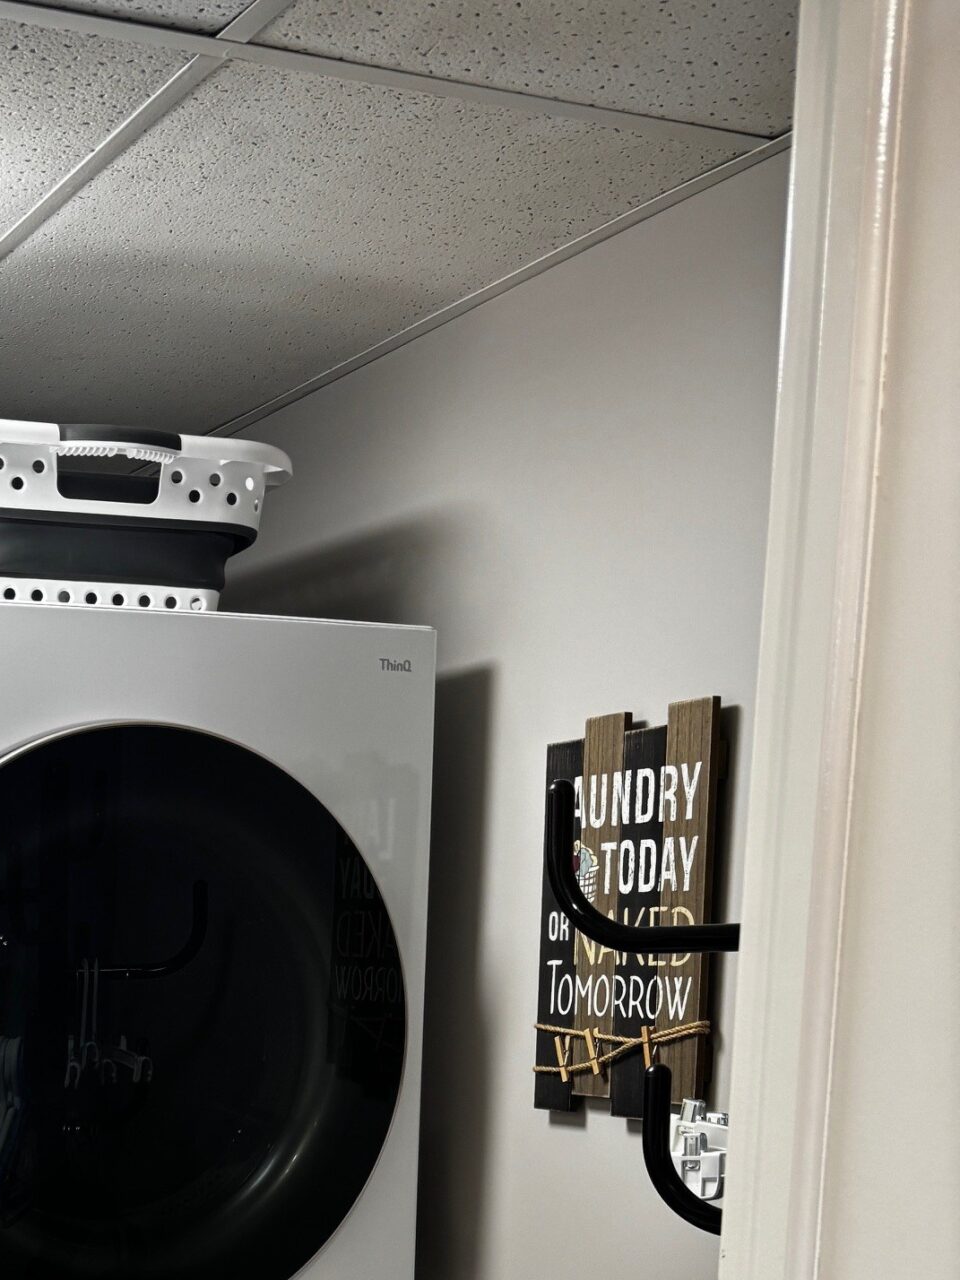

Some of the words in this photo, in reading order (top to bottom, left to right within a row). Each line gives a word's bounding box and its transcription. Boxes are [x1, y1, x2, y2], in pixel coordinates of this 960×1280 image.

[379, 658, 412, 672] ThinQ
[573, 761, 701, 829] AUNDRY
[600, 834, 699, 895] TODAY
[548, 910, 571, 942] OR
[546, 959, 693, 1021] TOMORROW
